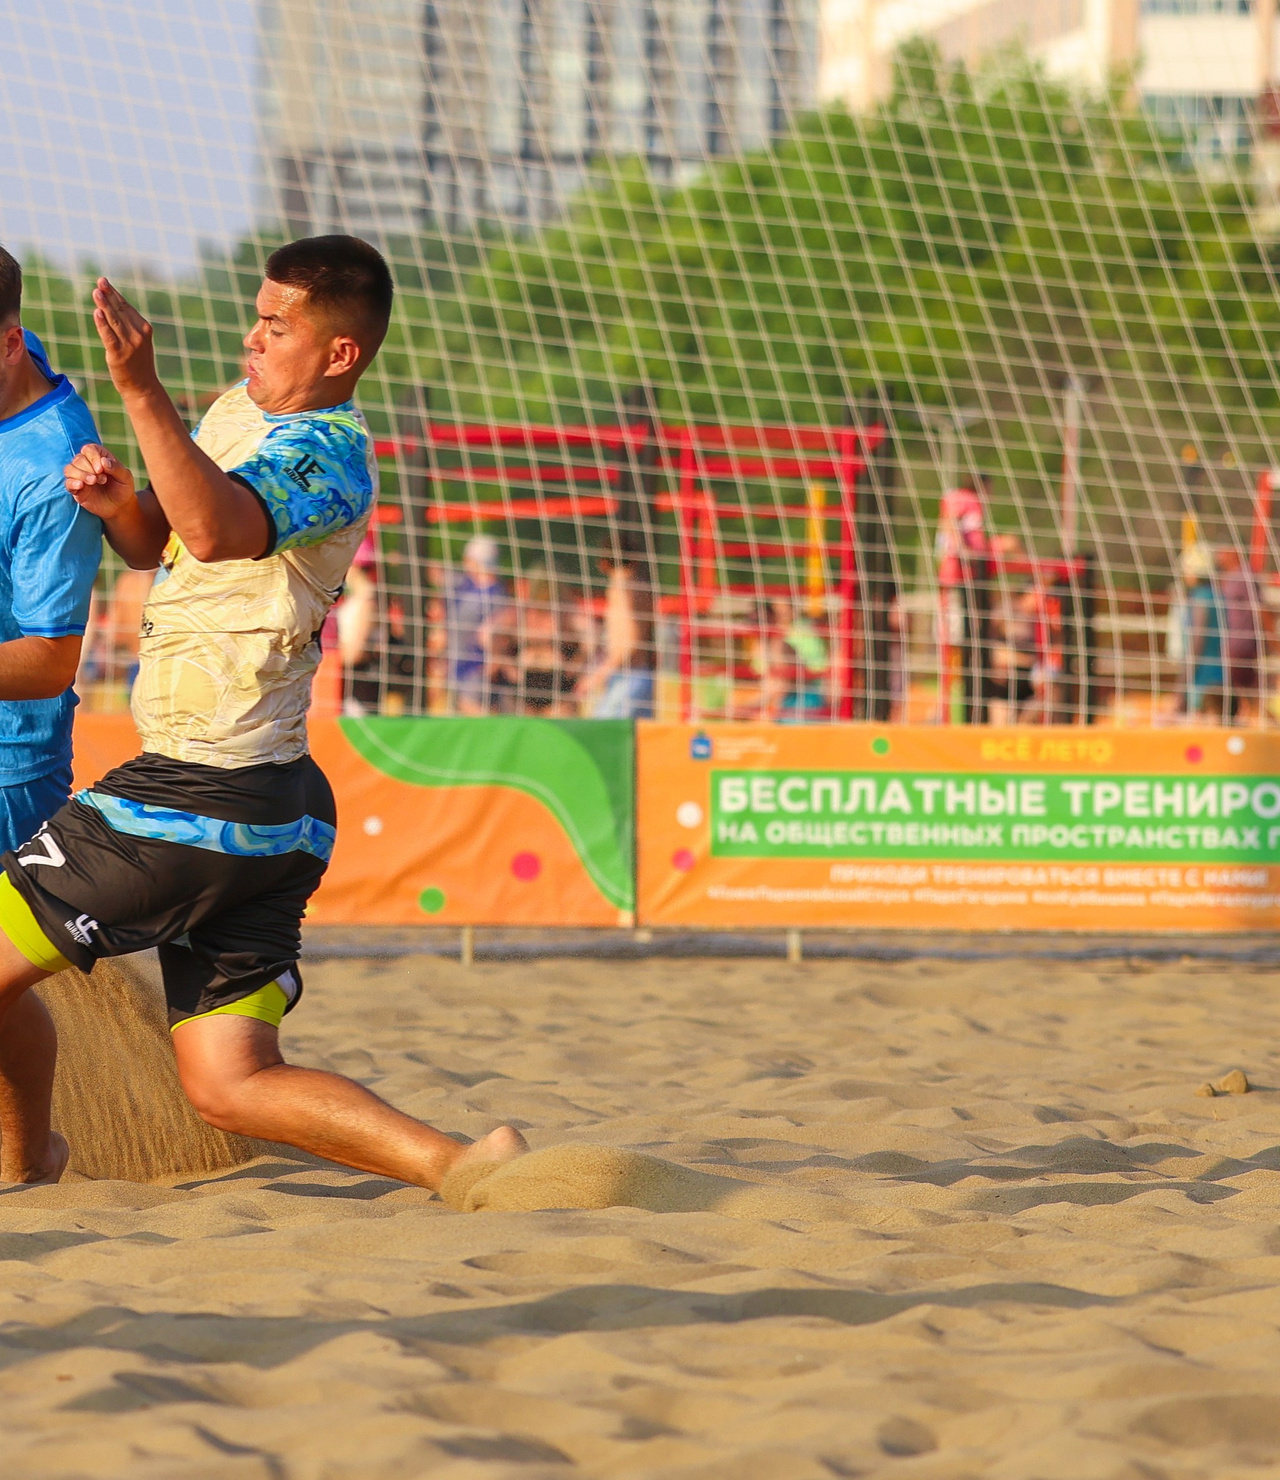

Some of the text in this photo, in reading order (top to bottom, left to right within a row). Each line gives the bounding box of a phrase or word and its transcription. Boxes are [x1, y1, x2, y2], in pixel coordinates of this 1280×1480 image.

[980, 736, 1113, 763] ВСЁ ЛЕТО
[719, 777, 1280, 819] БЕСПЛАТНЫЕ ТРЕНИРО
[718, 820, 759, 844] НА
[765, 820, 1004, 848] ОБЩЕСТВЕННЫХ
[1011, 823, 1261, 850] ПРОСТРАНСТВАХ
[1103, 867, 1182, 888] ВМЕСТЕ
[1185, 868, 1200, 888] С
